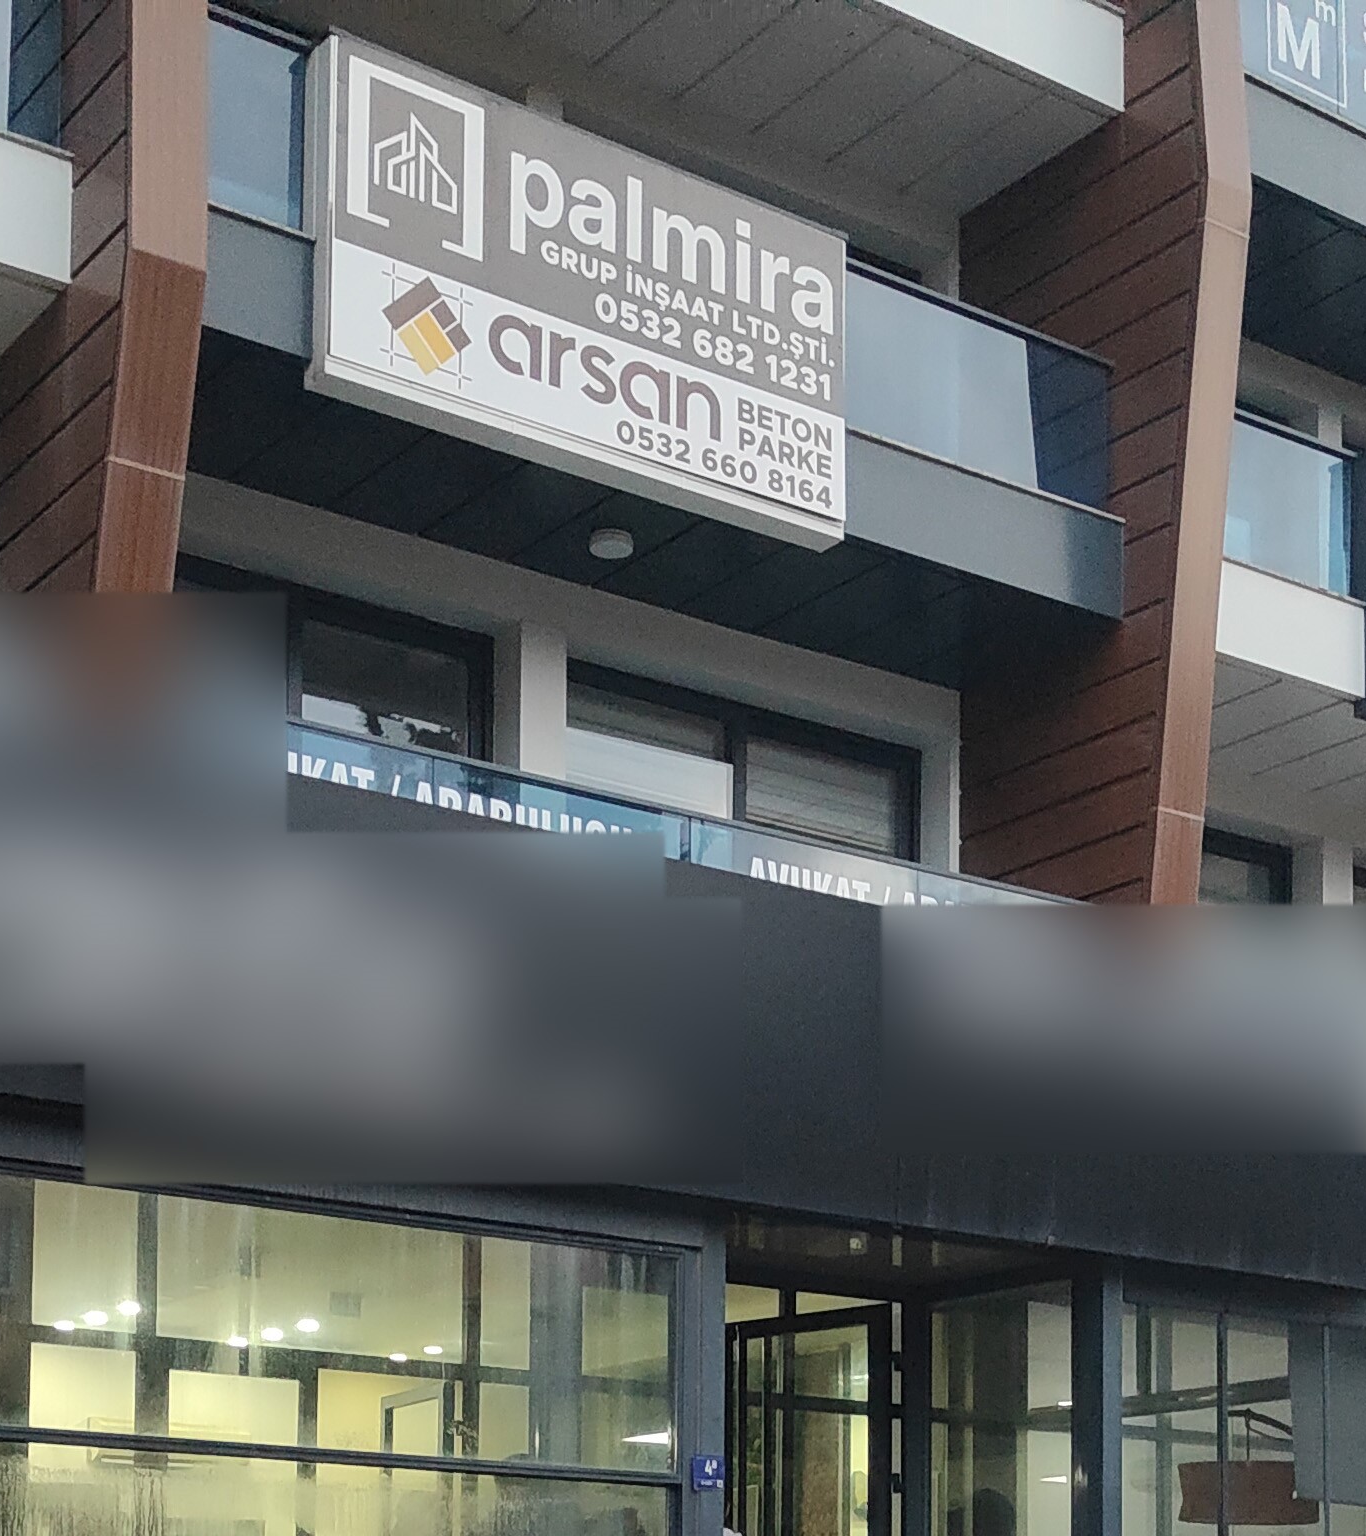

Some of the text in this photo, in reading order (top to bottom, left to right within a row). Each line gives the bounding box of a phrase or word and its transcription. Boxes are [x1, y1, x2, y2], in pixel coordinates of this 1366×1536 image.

[510, 151, 835, 335] palmira
[540, 240, 836, 368] GRUP İNŞAAT LTD.ŞTİ.
[595, 292, 831, 401] 0532 682 1231
[488, 314, 722, 443] arsan
[737, 397, 833, 453] BETON
[616, 420, 833, 510] 0532 660 8164
[738, 426, 833, 481] PARKE
